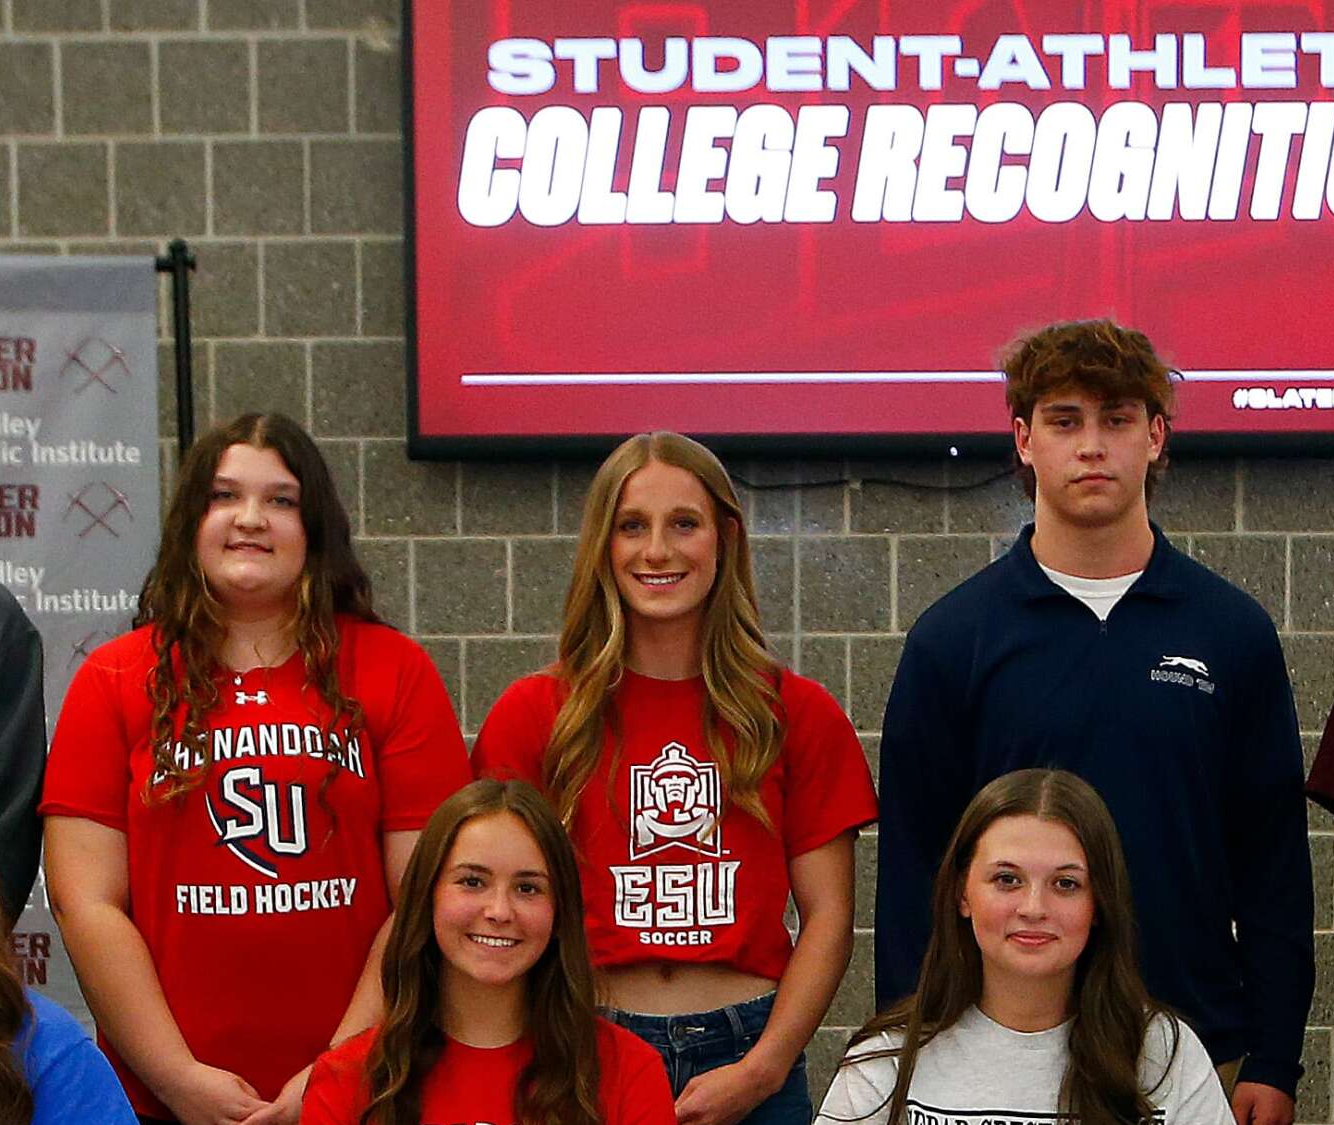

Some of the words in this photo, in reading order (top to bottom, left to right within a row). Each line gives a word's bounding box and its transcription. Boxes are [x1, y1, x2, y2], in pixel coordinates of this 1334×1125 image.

[457, 103, 851, 228] COLLEGE
[33, 441, 141, 463] Institute
[223, 767, 307, 854] SU
[177, 884, 247, 915] FIELD
[255, 877, 357, 913] HOCKEY
[609, 861, 741, 928] ESU
[639, 930, 712, 945] SOCCER
